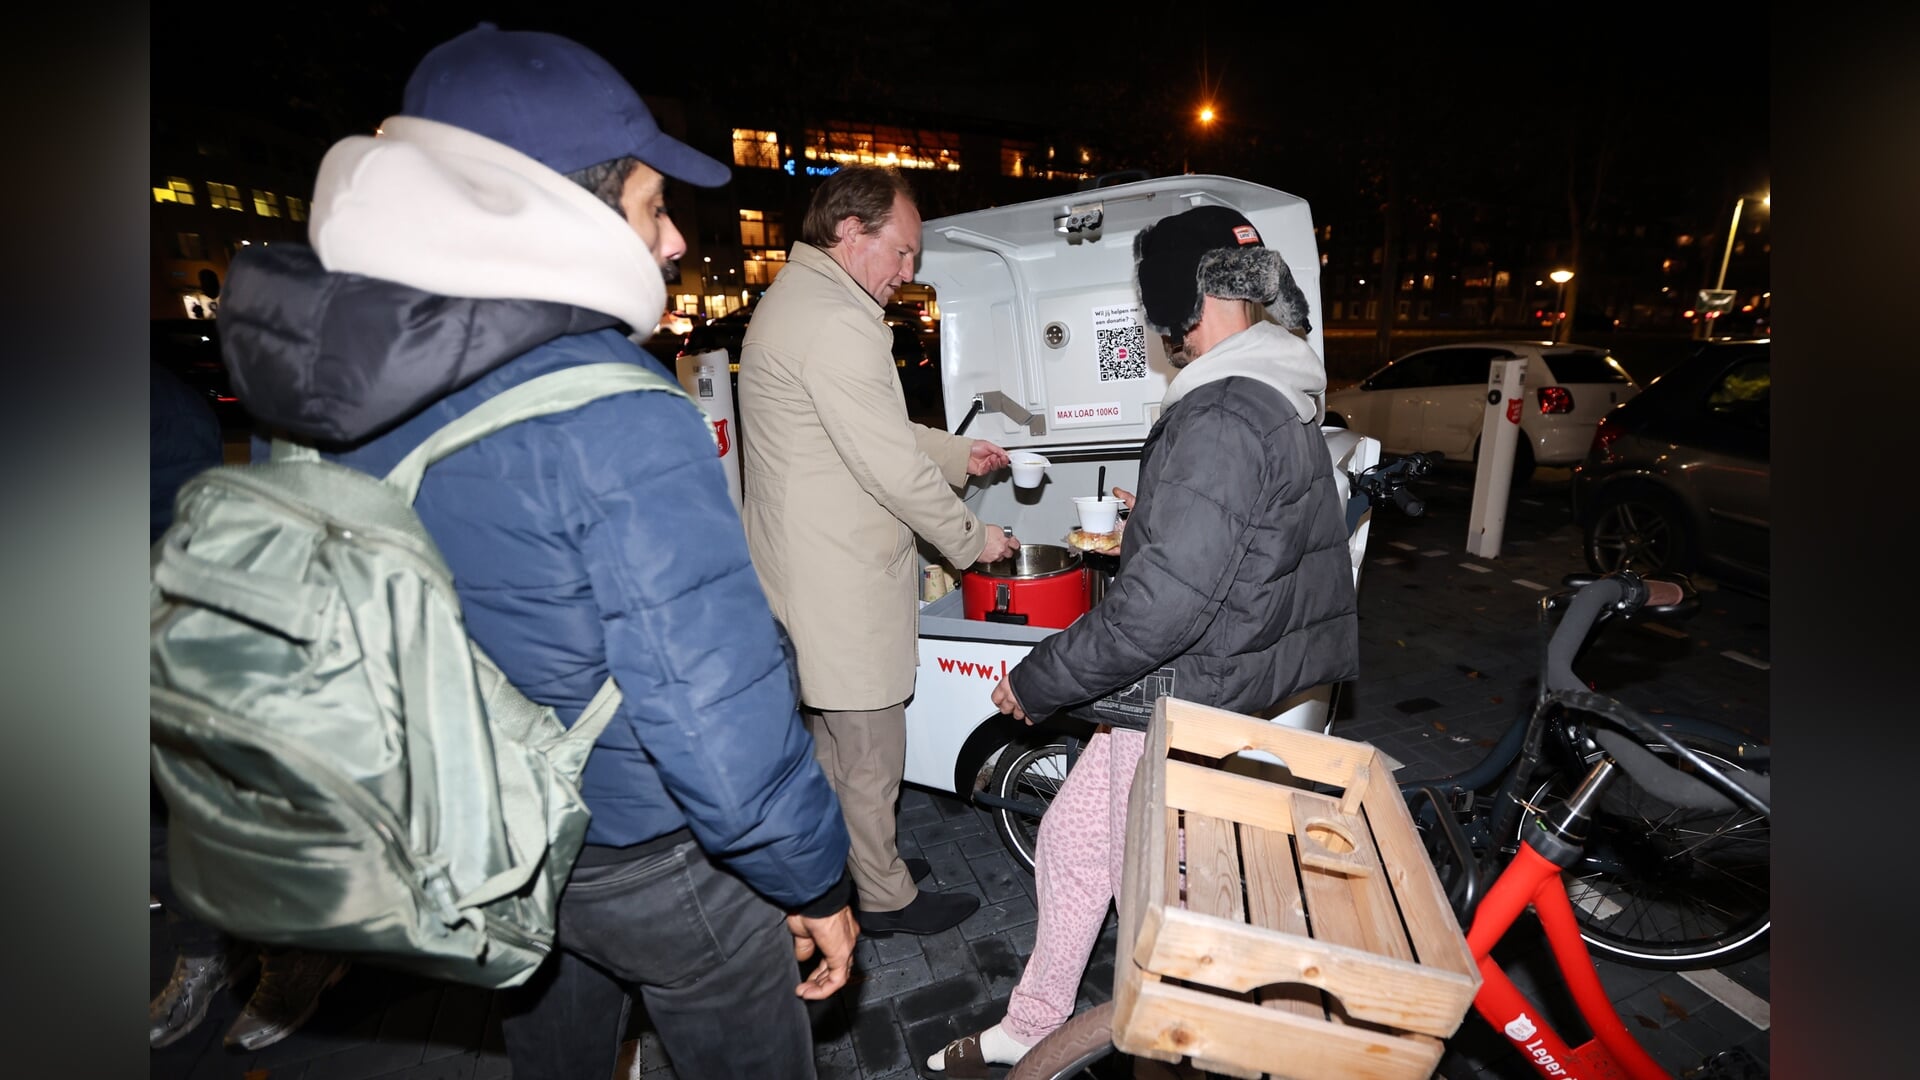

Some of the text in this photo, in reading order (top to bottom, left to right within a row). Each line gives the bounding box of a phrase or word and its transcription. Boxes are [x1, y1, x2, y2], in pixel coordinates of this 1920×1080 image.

[1107, 316, 1129, 324] donatie?
[1057, 407, 1119, 419] MAX LOAD 100KG
[937, 657, 1007, 681] www.l
[1526, 1039, 1567, 1076] Leger
